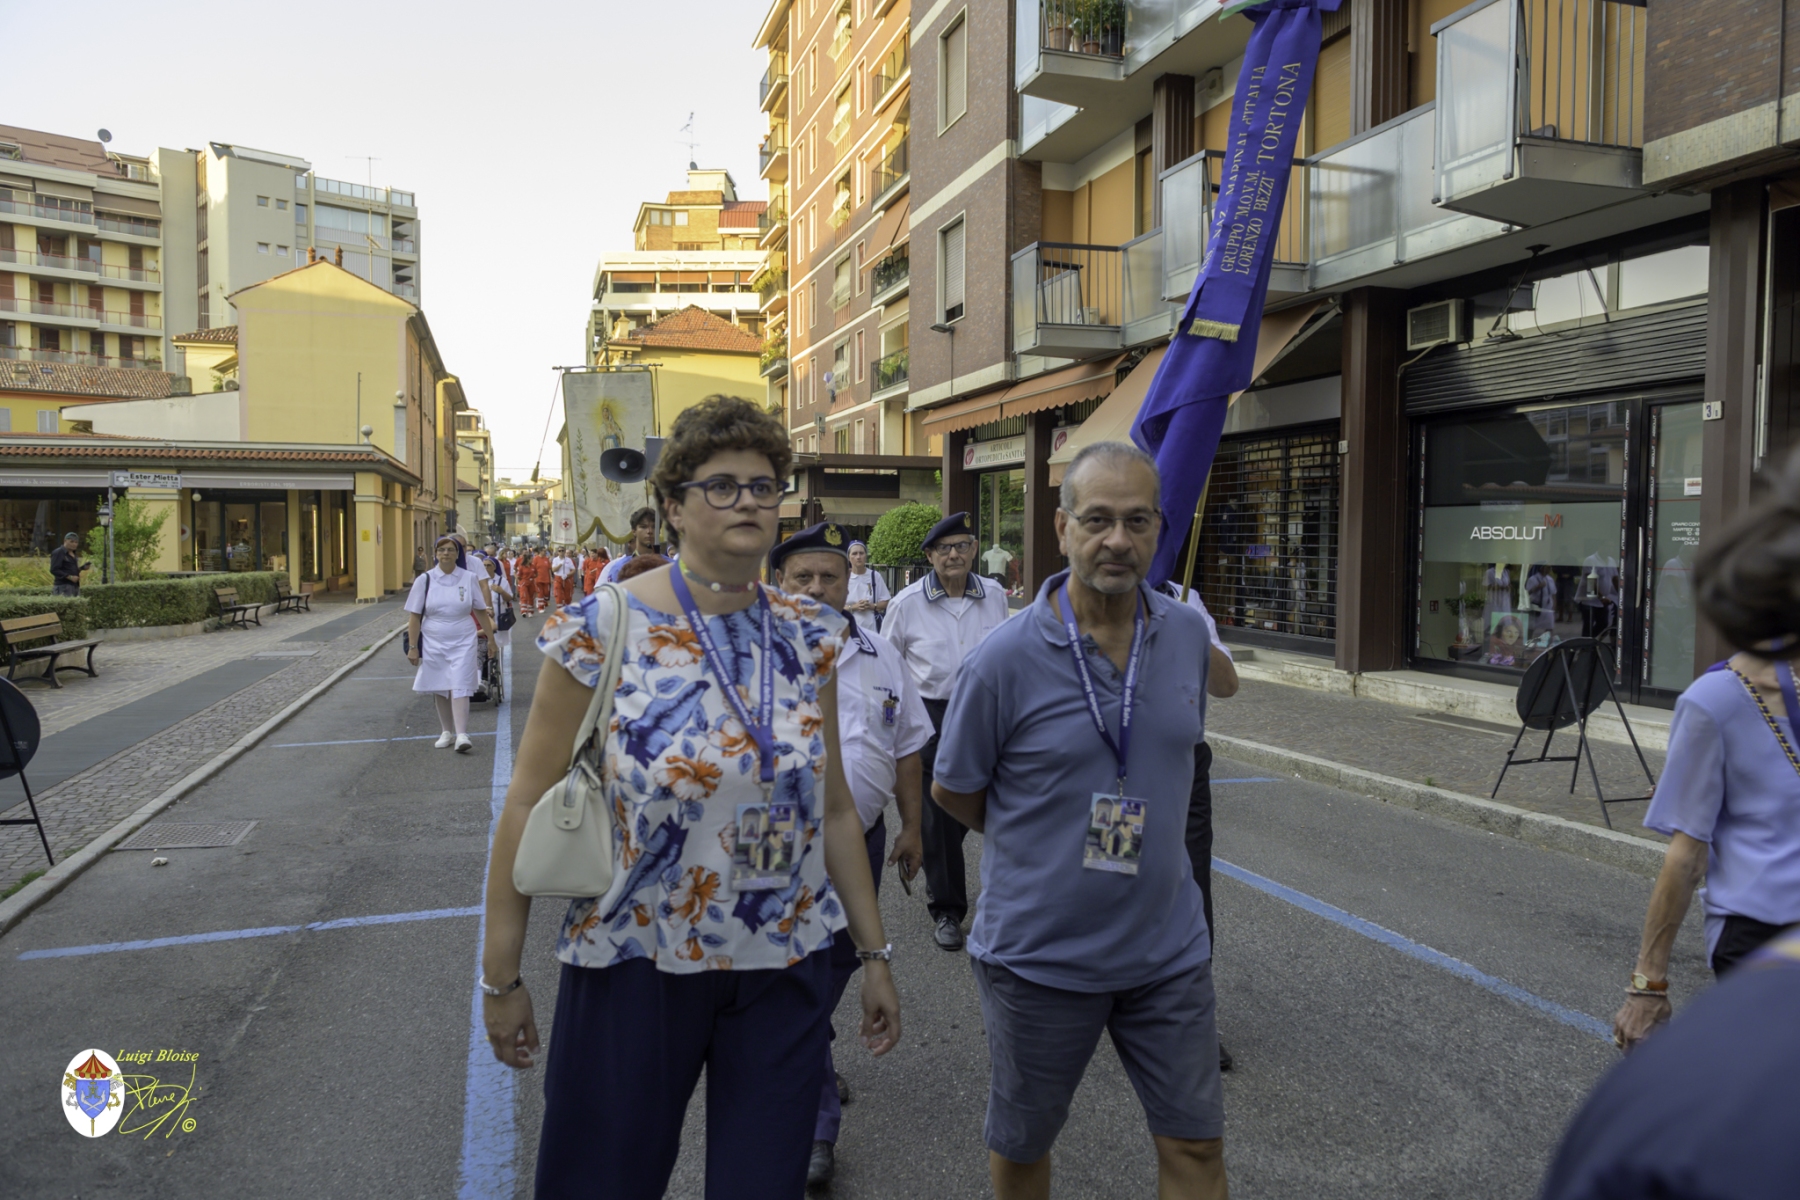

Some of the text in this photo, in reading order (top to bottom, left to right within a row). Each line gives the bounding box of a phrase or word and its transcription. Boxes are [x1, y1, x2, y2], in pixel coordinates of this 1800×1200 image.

[1256, 62, 1301, 164] TORTONA
[1220, 223, 1245, 272] GRUPPO
[1235, 218, 1264, 275] LORENZO
[975, 452, 1003, 464] ORTOPEDICI
[990, 441, 1013, 452] ARTICOLI
[1470, 526, 1547, 540] ABSOLUT
[1073, 641, 1083, 659] della
[710, 650, 730, 685] Madonna
[763, 650, 771, 684] Madonna
[1079, 659, 1093, 692] Madonna
[1125, 655, 1138, 687] Madonna
[1124, 687, 1132, 706] della
